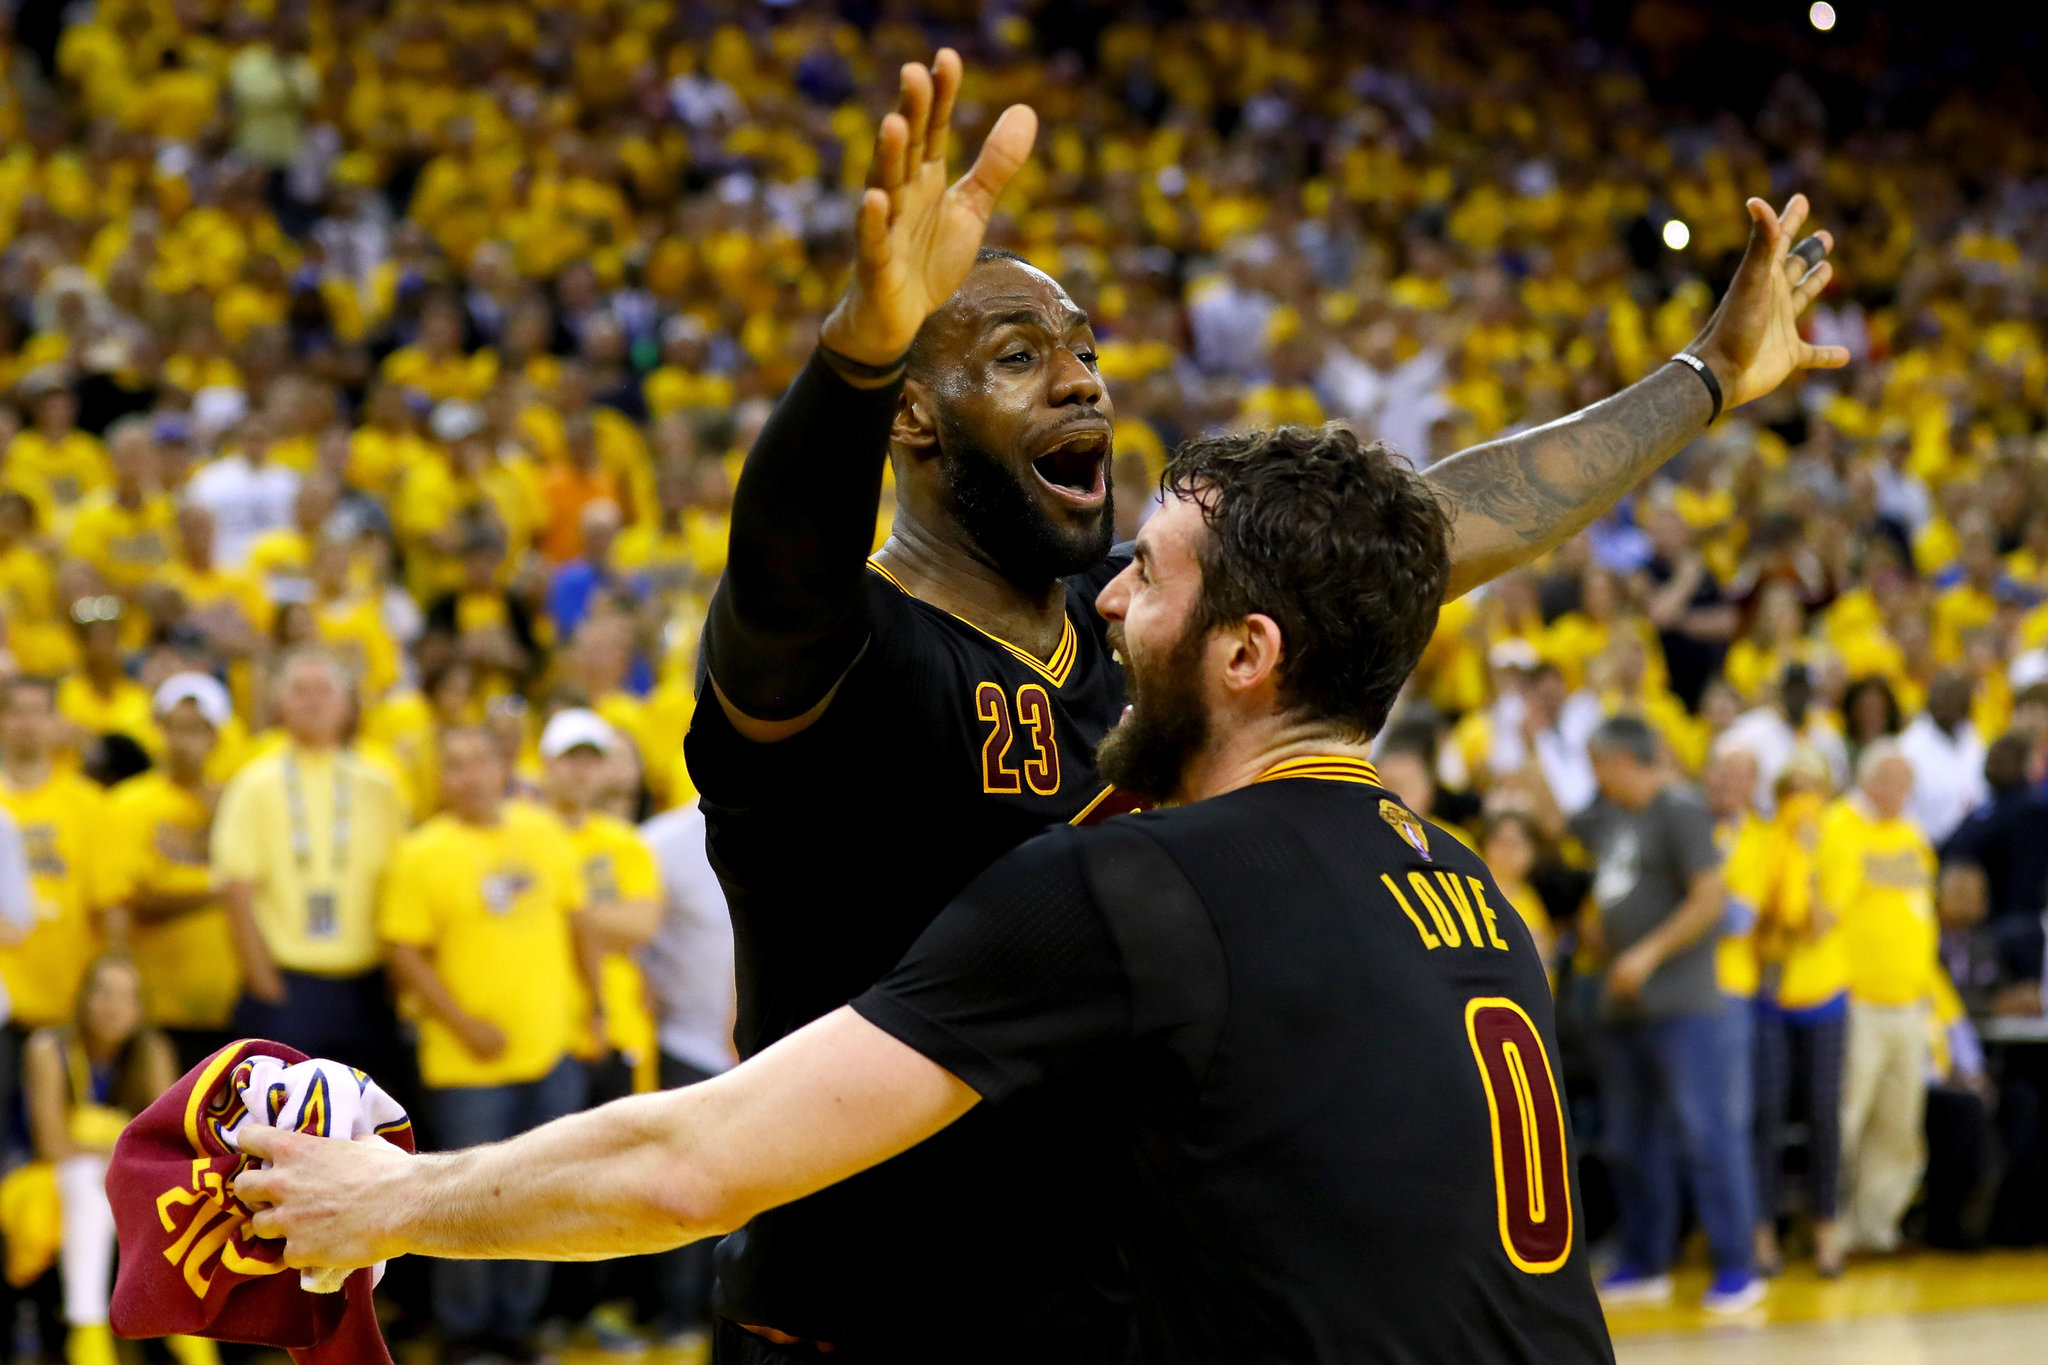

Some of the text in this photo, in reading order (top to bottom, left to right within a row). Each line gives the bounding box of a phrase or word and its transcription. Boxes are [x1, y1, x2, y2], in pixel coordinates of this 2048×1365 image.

[976, 681, 1060, 796] 23
[1380, 871, 1509, 951] LOVE
[1465, 997, 1573, 1274] 0
